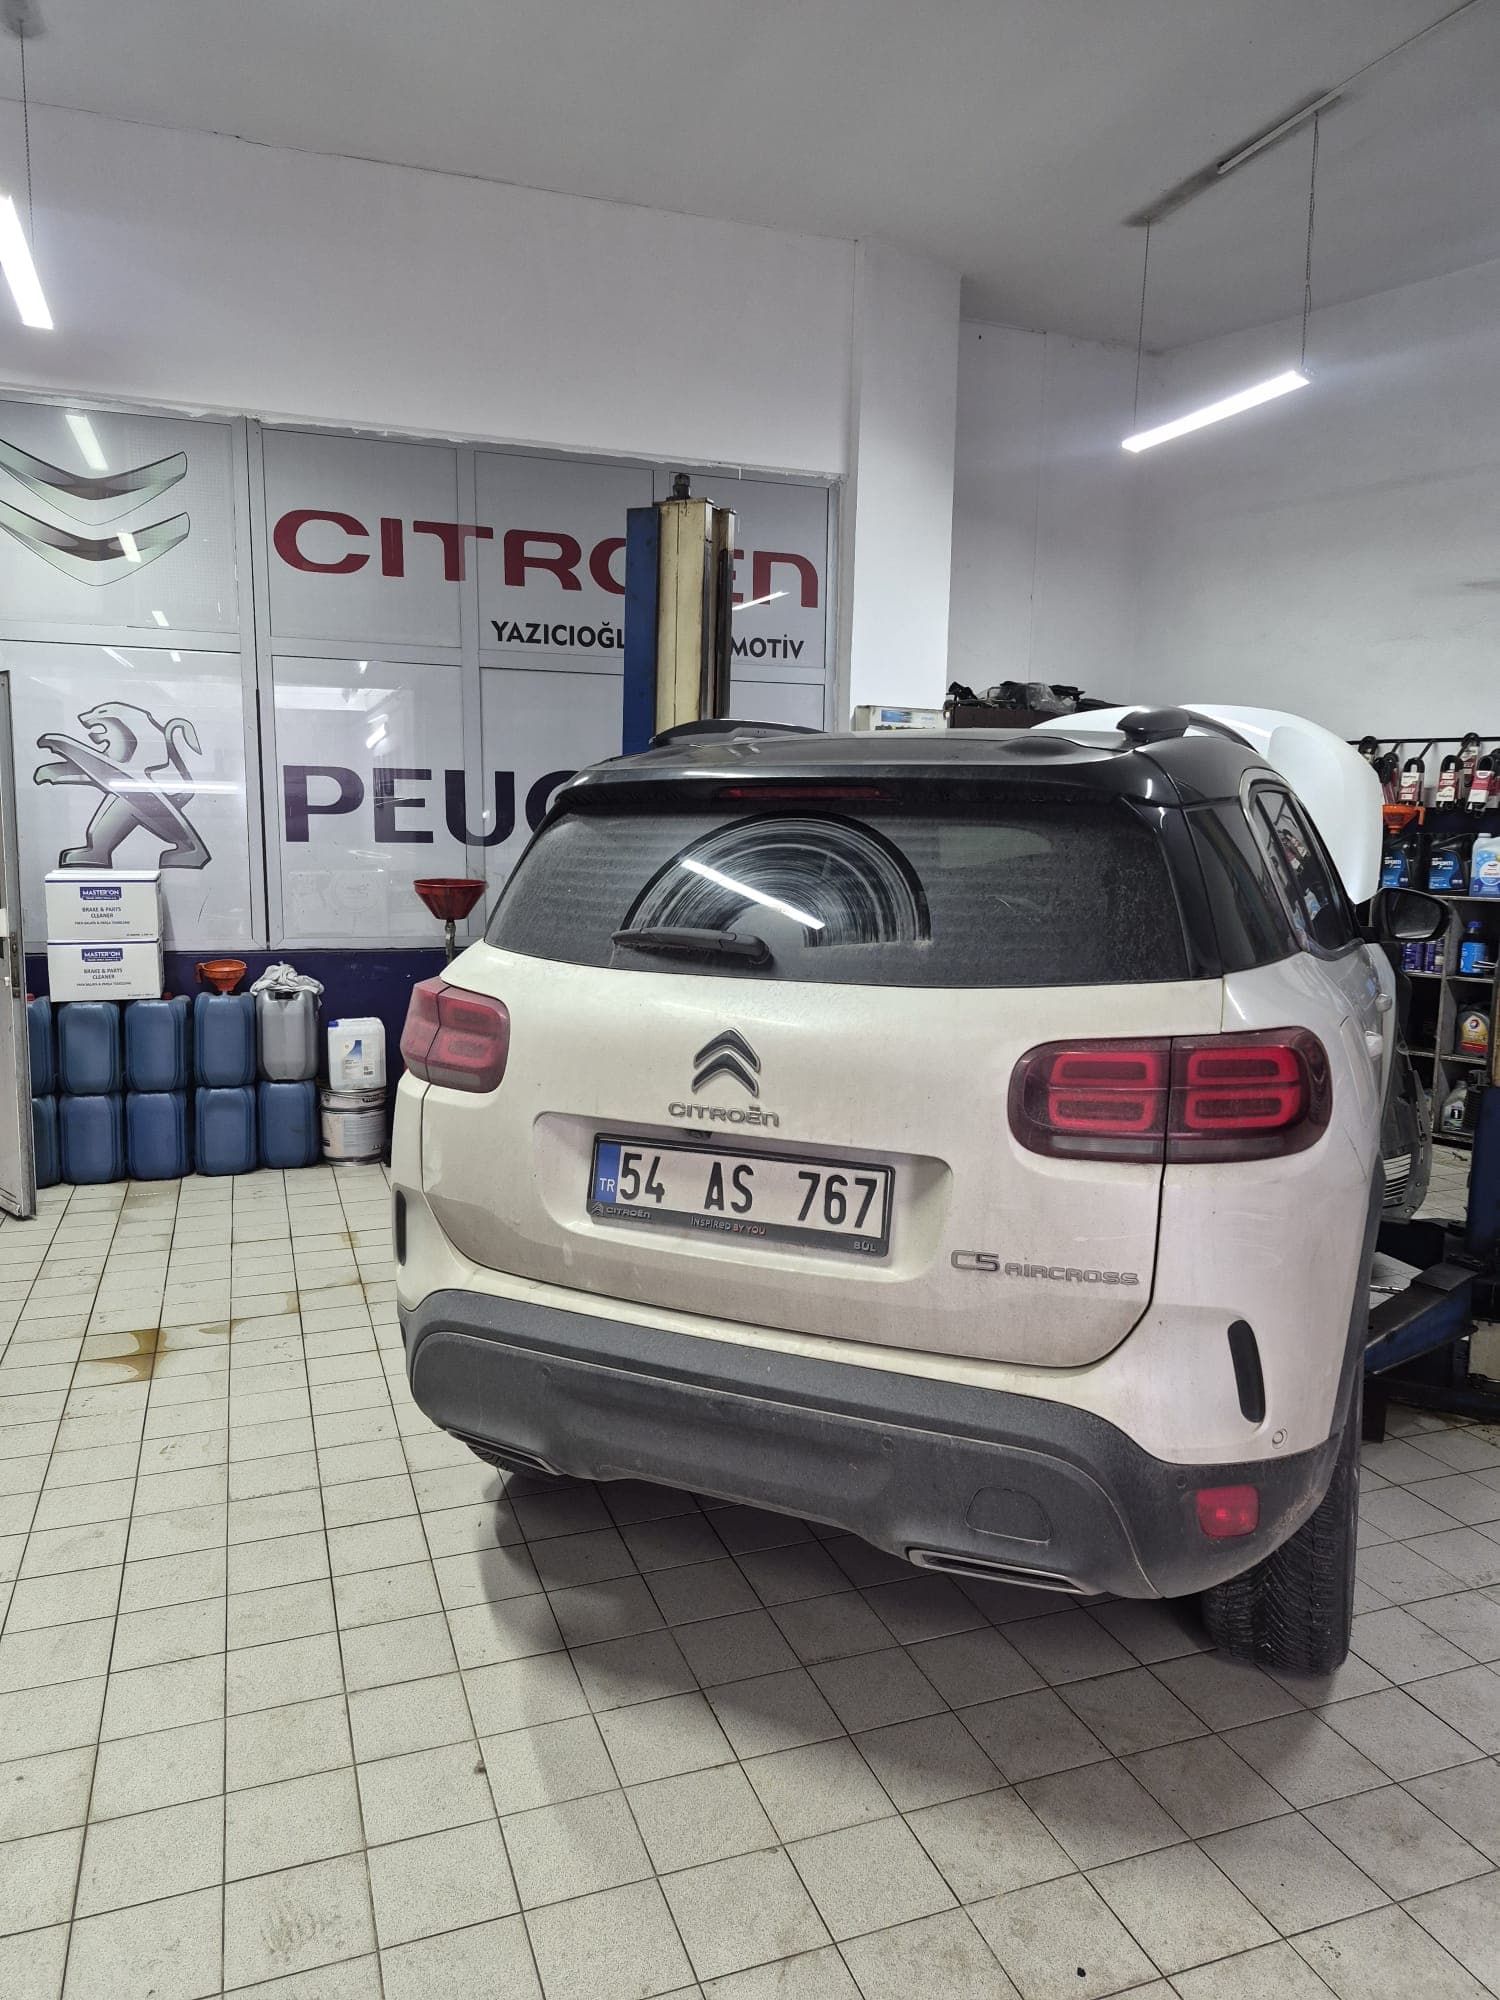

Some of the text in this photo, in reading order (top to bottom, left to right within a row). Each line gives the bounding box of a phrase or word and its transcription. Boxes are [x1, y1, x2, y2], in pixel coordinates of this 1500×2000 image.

[274, 509, 818, 608] CITRN
[600, 1178, 615, 1193] TR
[619, 1152, 877, 1229] 54 AS 767
[733, 1223, 744, 1232] BY
[746, 1226, 766, 1236] YOU
[951, 1250, 1140, 1286] C5 AIRCROSS
